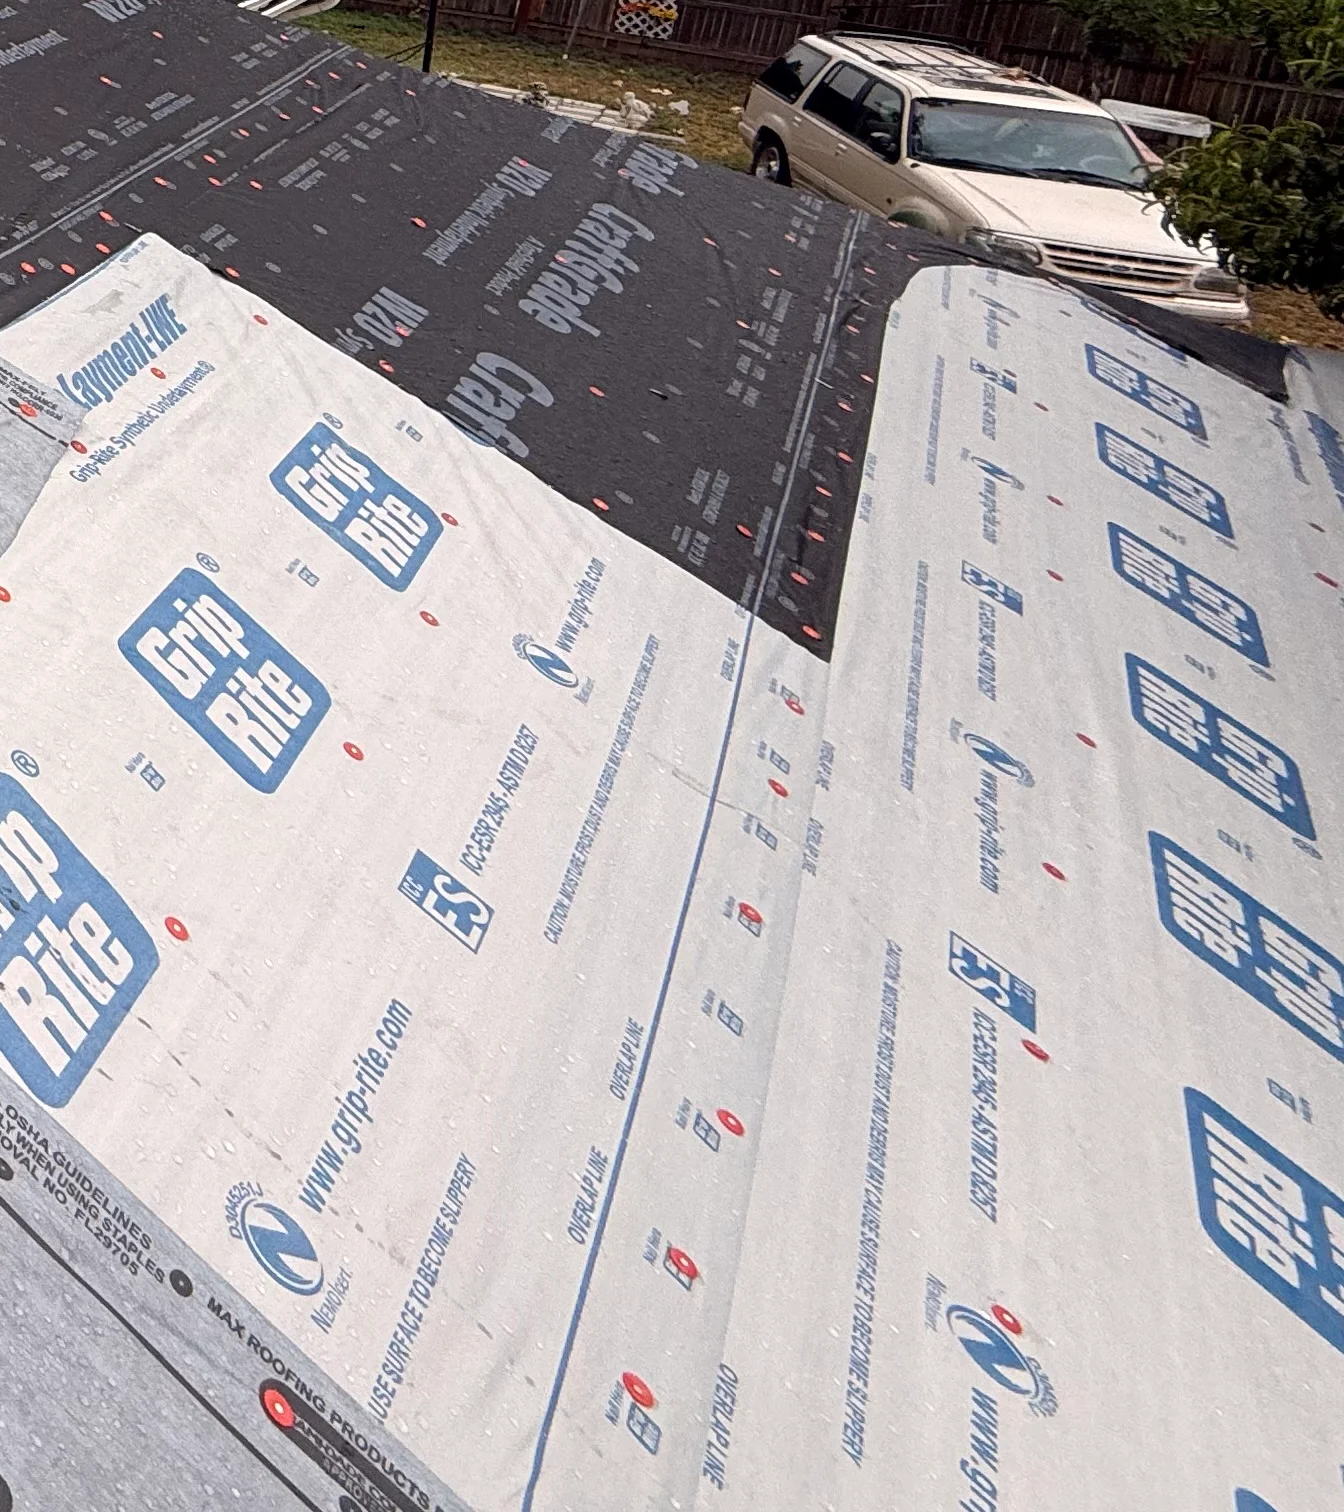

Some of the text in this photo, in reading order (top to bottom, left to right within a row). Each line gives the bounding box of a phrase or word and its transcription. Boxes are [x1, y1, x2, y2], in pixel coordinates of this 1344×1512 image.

[353, 286, 429, 348] W20
[68, 405, 160, 483] Grip-Rite Synthetic
[285, 440, 374, 524] Grip
[343, 491, 429, 579] Rite
[556, 556, 607, 654] www.grip-rite.com
[136, 591, 245, 700] Grip
[205, 659, 312, 775] Rite
[513, 723, 540, 756] 8257
[612, 724, 632, 753] CAUSE
[619, 694, 642, 731] SURFACE
[495, 755, 527, 797] ASTM
[597, 762, 619, 795] DEBRIS
[606, 747, 625, 768] MAY
[481, 791, 511, 828] 2945
[592, 789, 610, 812] AND
[974, 768, 1002, 895] www.grip-rite.com
[459, 818, 499, 877] ICC-ESR
[400, 875, 425, 900] ICC
[422, 873, 488, 952] ES
[543, 899, 571, 945] CAUTION:
[1163, 849, 1252, 966] Rite
[952, 940, 1014, 1009] ES
[609, 1016, 645, 1101] OVERLAP LINE
[972, 1006, 998, 1076] ICC-ESR
[296, 995, 415, 1214] www.grip-rite.com
[870, 1094, 891, 1125] AND
[971, 1064, 998, 1112] 2945
[867, 1118, 889, 1169] DEBRIS
[970, 1107, 999, 1169] ASTM
[8, 1131, 63, 1177] WHEN
[48, 1172, 109, 1221] USING
[95, 1217, 175, 1285] STAPLES
[40, 1151, 153, 1250] GUIDELINES
[567, 1145, 609, 1245] OVERLAP LINE
[860, 1187, 883, 1240] CAUSE
[864, 1163, 887, 1195] MAY
[969, 1170, 998, 1224] 8257
[1200, 1108, 1318, 1289] Rite
[42, 1176, 78, 1211] NO.
[73, 1207, 145, 1276] FL29705
[367, 1152, 477, 1420] USE SURFACE TO BECOME SLIPPERY
[854, 1232, 880, 1303] SURFACE
[852, 1297, 875, 1323] TO
[847, 1314, 873, 1389] BECOME
[206, 1296, 430, 1511] MAX ROOFING PRODUCTS
[702, 1362, 739, 1491] OVERLAP LINE
[841, 1381, 870, 1469] SLIPPERY
